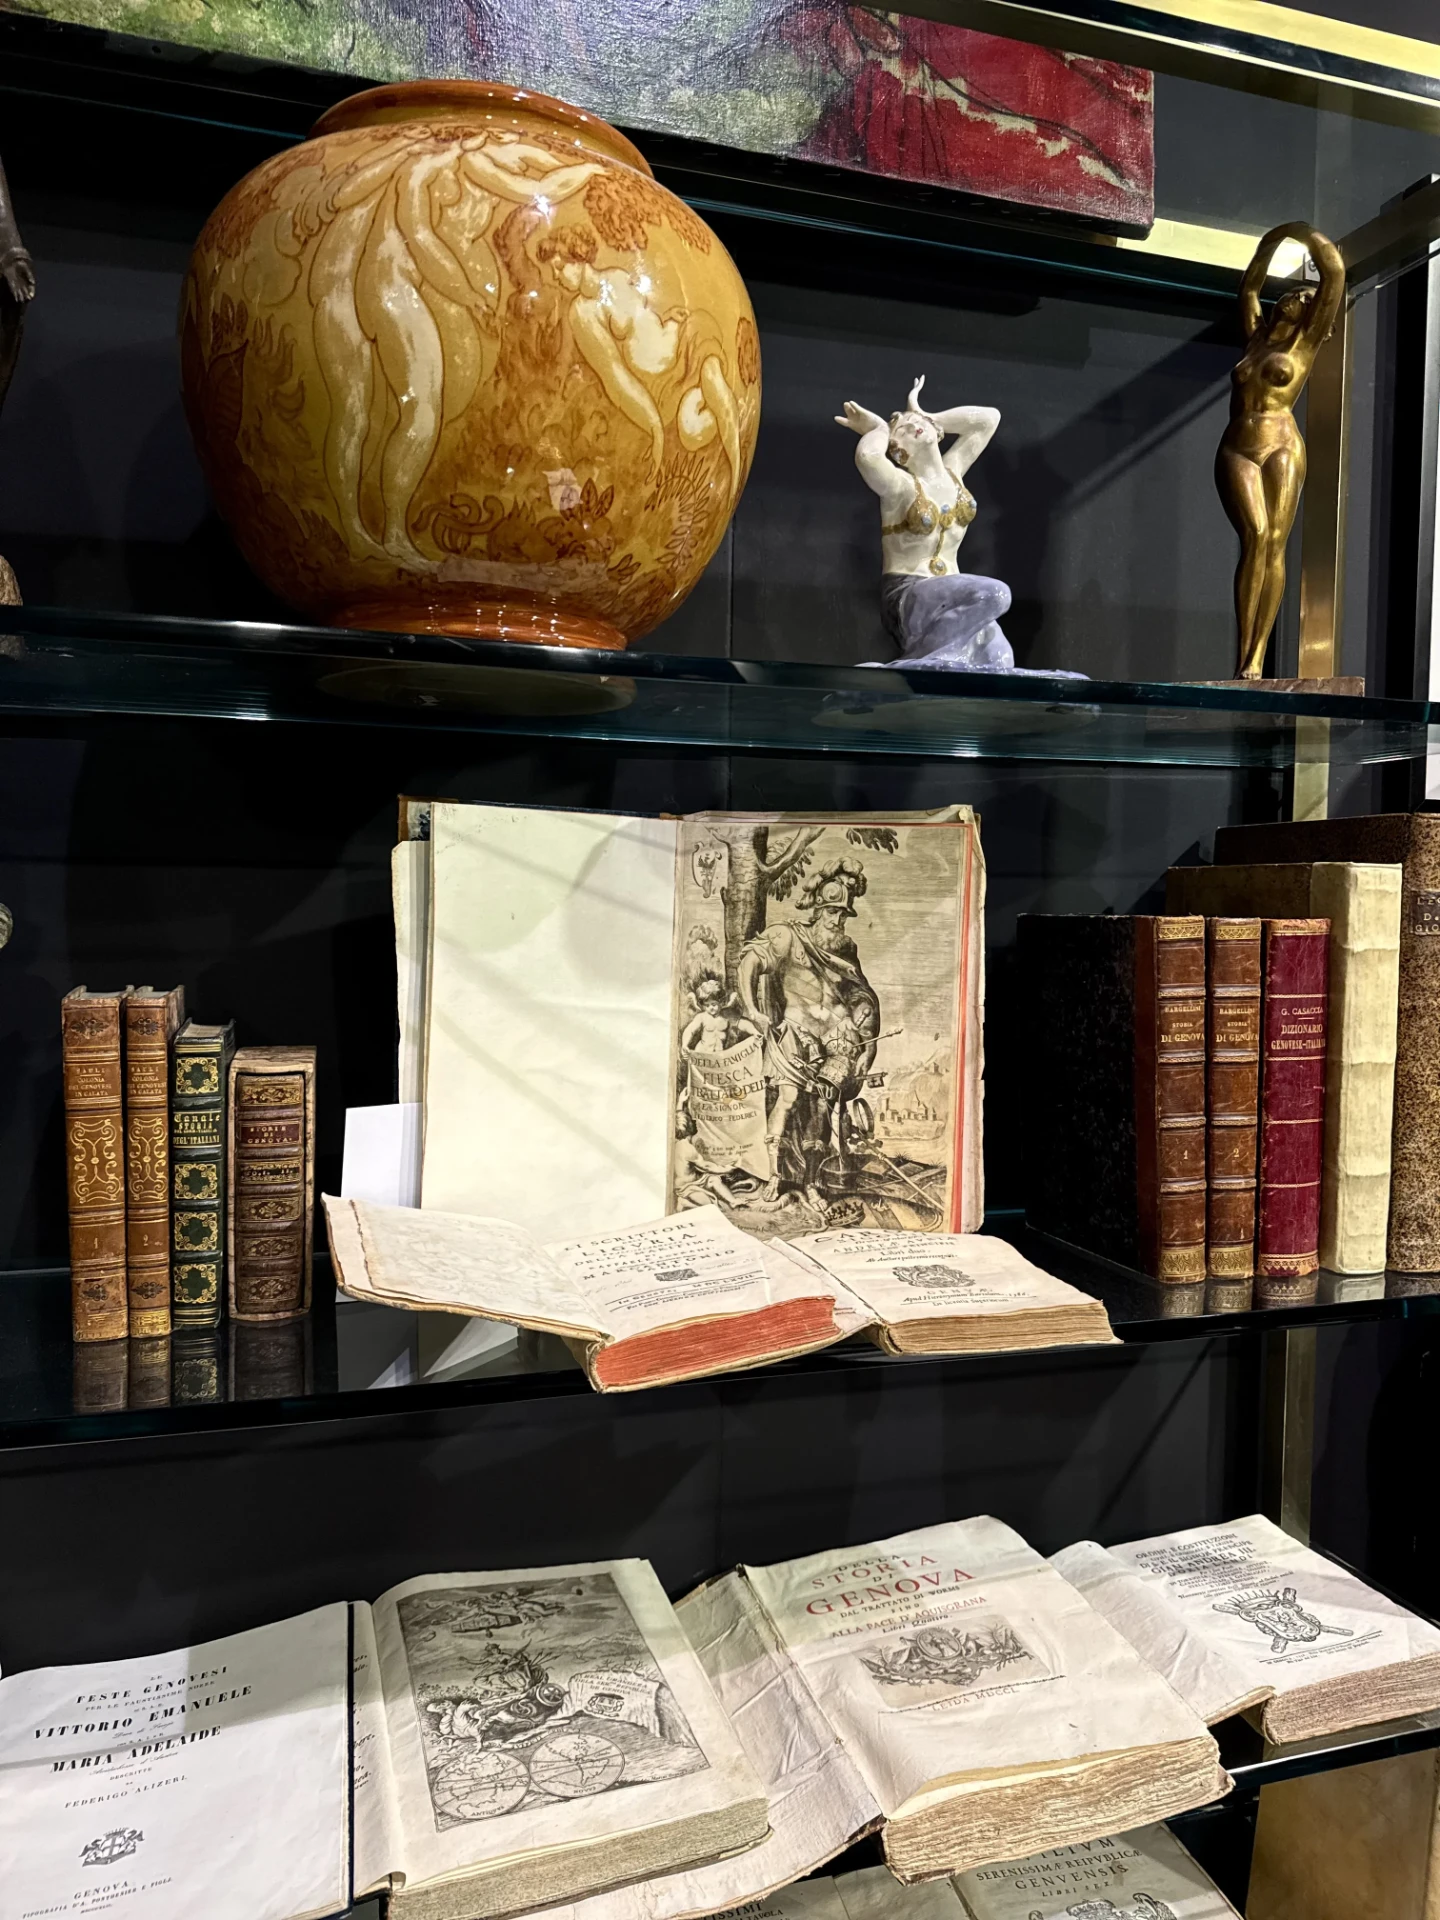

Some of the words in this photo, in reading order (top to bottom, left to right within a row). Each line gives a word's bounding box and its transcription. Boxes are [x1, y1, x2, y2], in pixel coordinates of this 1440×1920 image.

[1281, 1008, 1290, 1016] G.
[1281, 1023, 1323, 1035] DIZIONARIO
[1161, 1034, 1173, 1043] DI
[1174, 1032, 1205, 1042] GENOVA
[1215, 1034, 1227, 1043] DI
[1229, 1033, 1258, 1042] GENOVA
[703, 1066, 754, 1085] FIESCA
[174, 1112, 221, 1123] Canale
[178, 1122, 213, 1130] STORIA
[1233, 1148, 1240, 1158] 2
[143, 1234, 149, 1247] 2
[836, 1554, 901, 1572] DELLA
[1187, 1551, 1237, 1568] ANDREA
[811, 1555, 938, 1590] STORIA
[872, 1573, 895, 1583] DI
[805, 1567, 976, 1616] GENOVA
[840, 1609, 860, 1618] DAL
[861, 1596, 910, 1612] TRATTATO
[913, 1592, 925, 1600] DI
[928, 1585, 961, 1596] WORMS
[832, 1625, 863, 1638] ALLA
[866, 1617, 897, 1630] PACE
[914, 1595, 987, 1619] AQUISGRANA
[882, 1623, 907, 1634] Libri
[76, 1689, 132, 1704] FESTE
[143, 1666, 228, 1695] GENOVESI
[85, 1704, 102, 1712] PER
[932, 1697, 970, 1712] LEIDA
[34, 1717, 134, 1740] VITTORIO
[149, 1685, 253, 1723] EMANUELE
[50, 1753, 114, 1774] MARIA
[127, 1725, 222, 1760] ADELAIDE
[109, 1766, 153, 1781] DESCRITTE
[64, 1790, 129, 1809] FEDERIGO
[1067, 1849, 1143, 1869] REIPVBLICÆ
[1015, 1863, 1129, 1890] GENVENSIS
[73, 1880, 130, 1900] GENOVA
[22, 1904, 68, 1919] TIPOGRAFIA
[746, 1909, 784, 1920] TAVOLA
